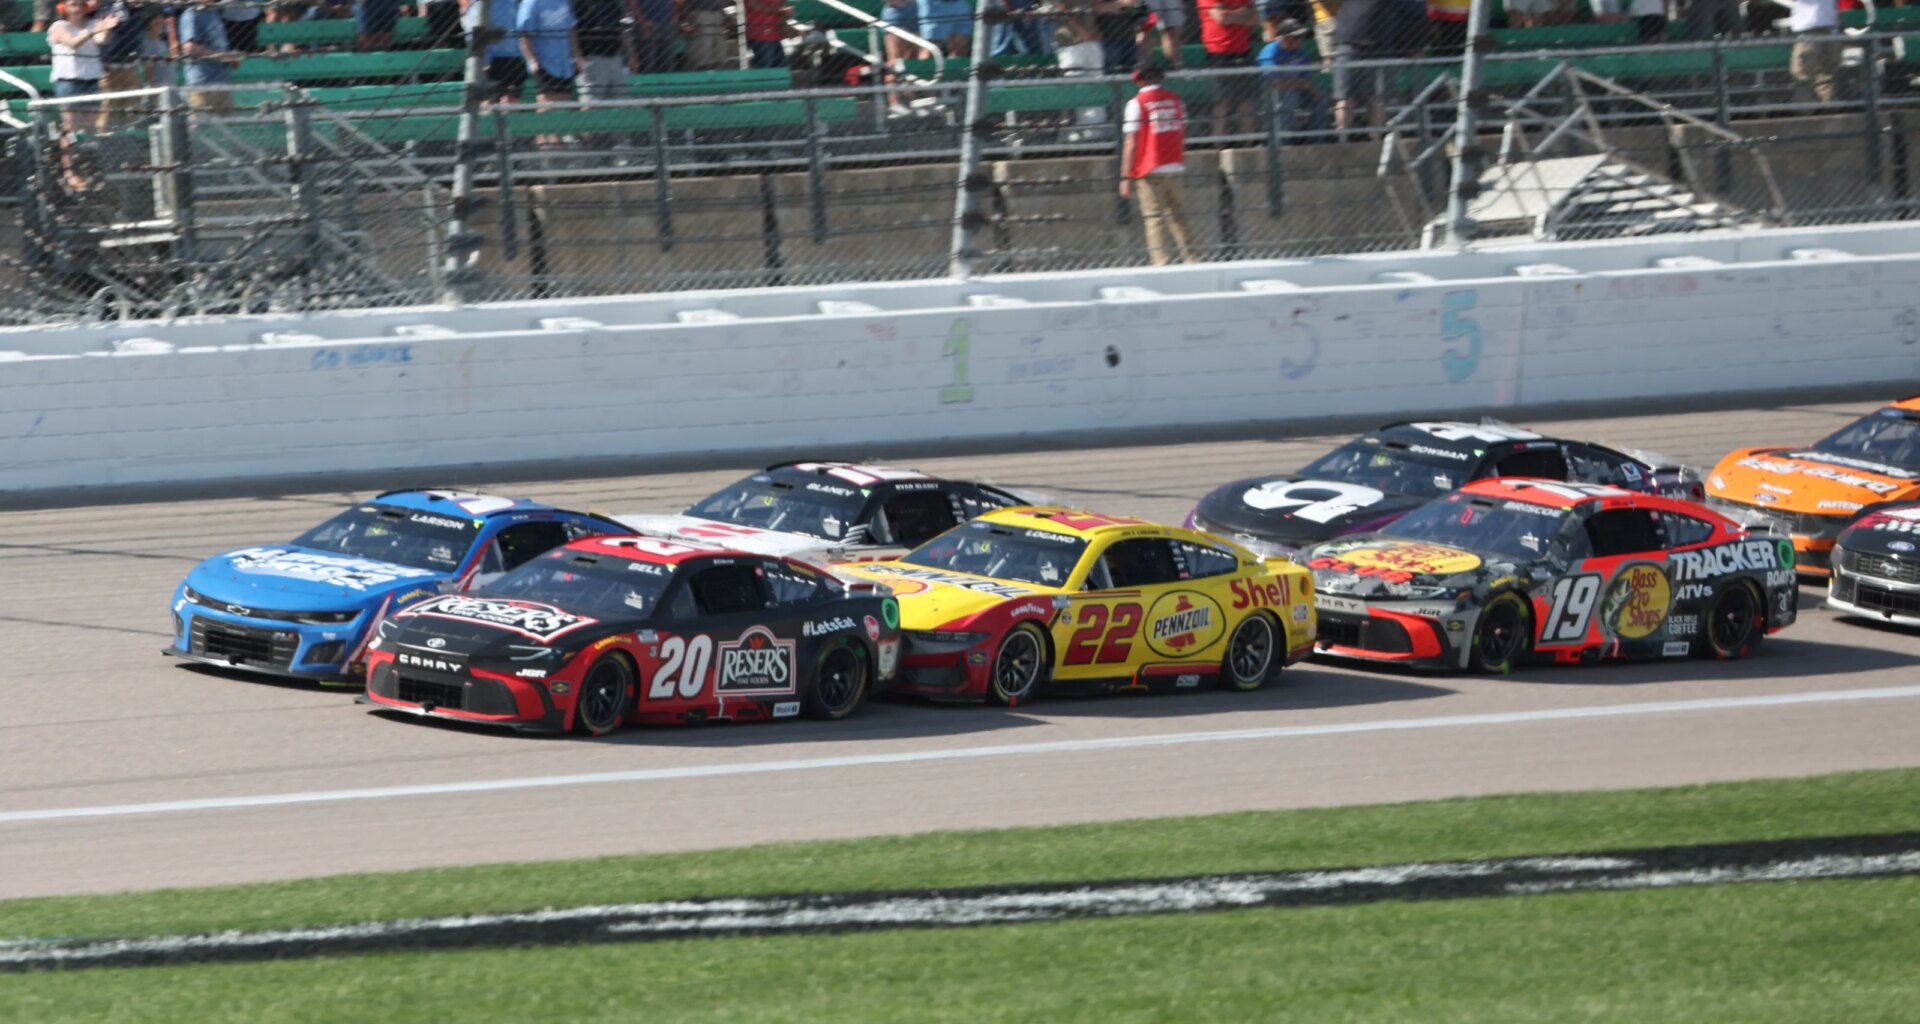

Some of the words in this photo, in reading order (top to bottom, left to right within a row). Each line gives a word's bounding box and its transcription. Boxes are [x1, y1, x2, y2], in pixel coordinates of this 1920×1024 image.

[1441, 290, 1481, 382] 5
[938, 318, 974, 404] 1
[1409, 444, 1468, 461] BOWMAN
[806, 483, 855, 497] BLANEY
[1504, 501, 1562, 518] BRISCOE
[410, 513, 465, 530] LARSON
[1025, 529, 1075, 544] LOGANO
[628, 562, 663, 576] BELL
[1667, 541, 1777, 580] TRACKER
[1631, 568, 1658, 588] Bass
[1766, 570, 1796, 587] BOATS
[1229, 574, 1291, 609] Shell
[1629, 589, 1650, 607] Pro
[1675, 583, 1713, 600] ATVs
[1542, 574, 1601, 641] 19
[803, 616, 856, 637] #LetsEat
[1152, 606, 1212, 640] PENNZOIL
[1627, 607, 1662, 631] Shops
[1668, 623, 1698, 634] COFFEE
[1062, 602, 1143, 667] 22
[399, 653, 462, 672] CAMRY
[649, 634, 713, 698] 20
[721, 645, 787, 687] RESER'S
[516, 668, 546, 678] JGR
